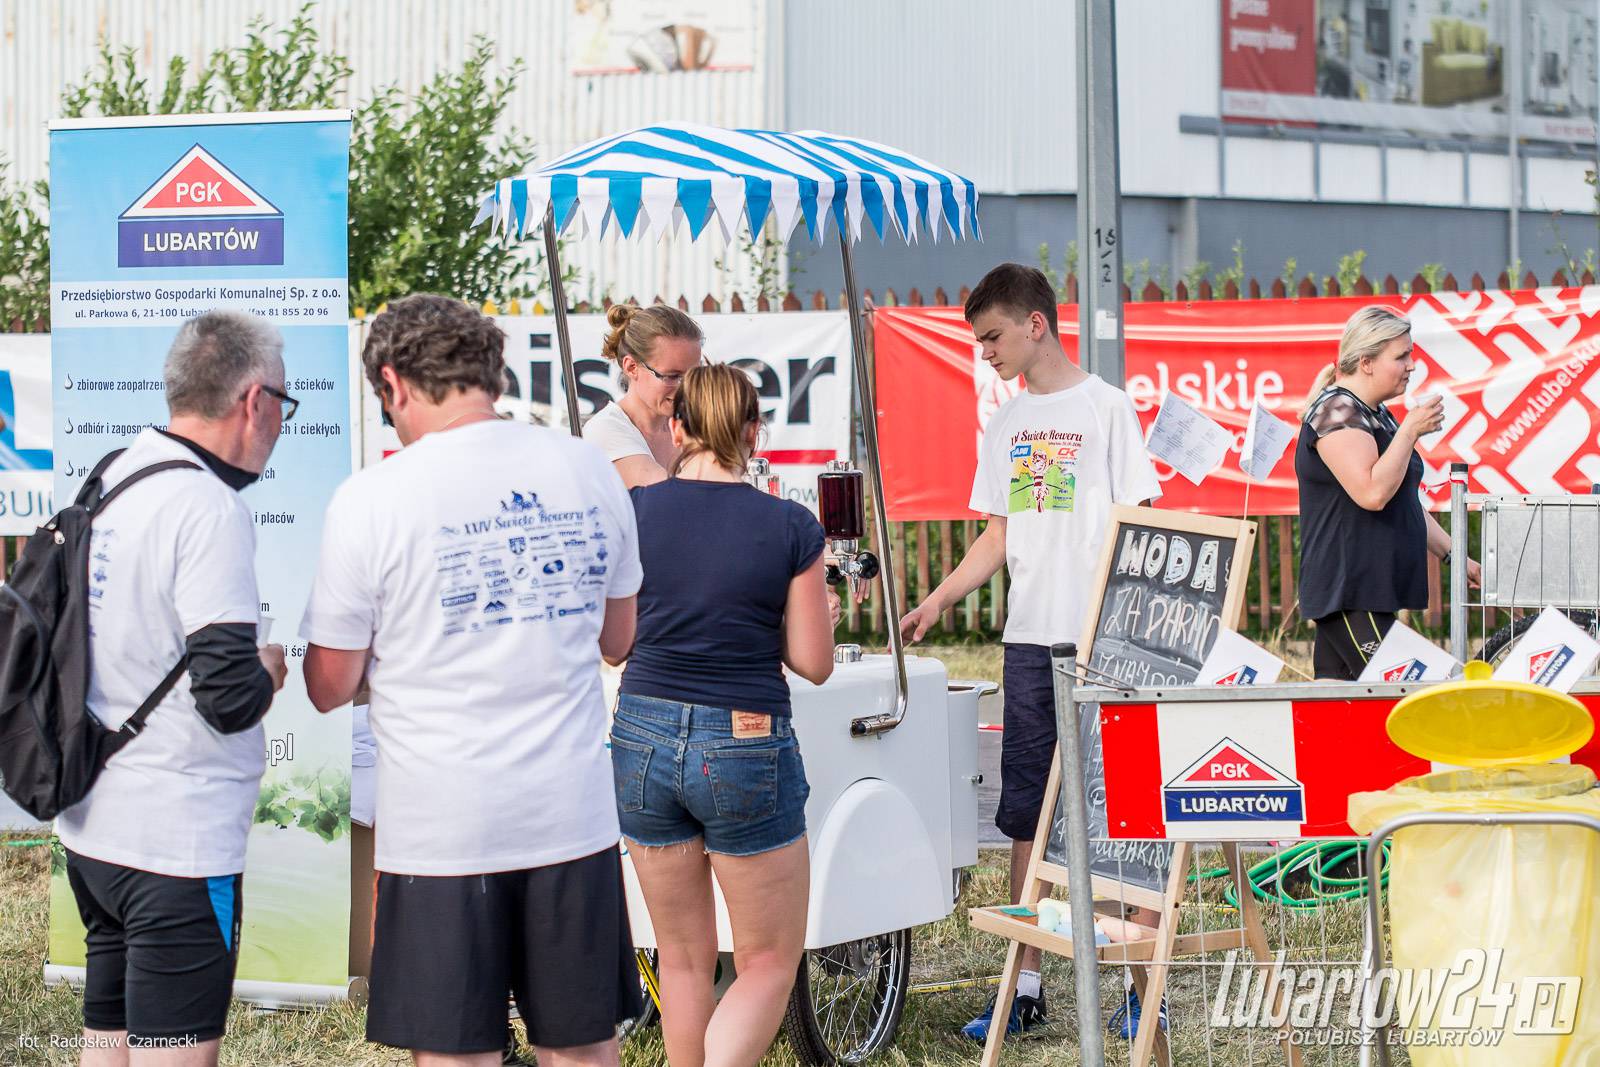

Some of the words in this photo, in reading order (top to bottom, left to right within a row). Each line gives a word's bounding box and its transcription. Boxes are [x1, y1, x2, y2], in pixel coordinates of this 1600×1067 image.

[175, 181, 223, 203] PGK
[143, 227, 260, 253] LUBARTÓW
[61, 289, 152, 303] Przedsiębiorstwo
[155, 287, 217, 302] Gospodarki
[220, 286, 286, 301] Komunalnej
[290, 286, 309, 301] Sp.
[312, 289, 319, 299] z
[321, 288, 341, 299] o.o.
[75, 309, 87, 319] ul.
[89, 309, 129, 319] Parkowa
[131, 308, 140, 319] 6,
[143, 308, 178, 318] 21-100
[268, 307, 279, 317] 81
[282, 307, 300, 317] 855
[303, 307, 315, 317] 20
[317, 307, 329, 317] 96
[77, 378, 115, 391] zbiorowe
[294, 378, 335, 391] ścieków
[77, 421, 105, 434] odbiór
[300, 423, 341, 438] ciekłych
[261, 512, 295, 526] placów
[1116, 529, 1220, 593] WODA
[1210, 763, 1250, 779] PGK
[1180, 794, 1288, 814] LUBARTÓW
